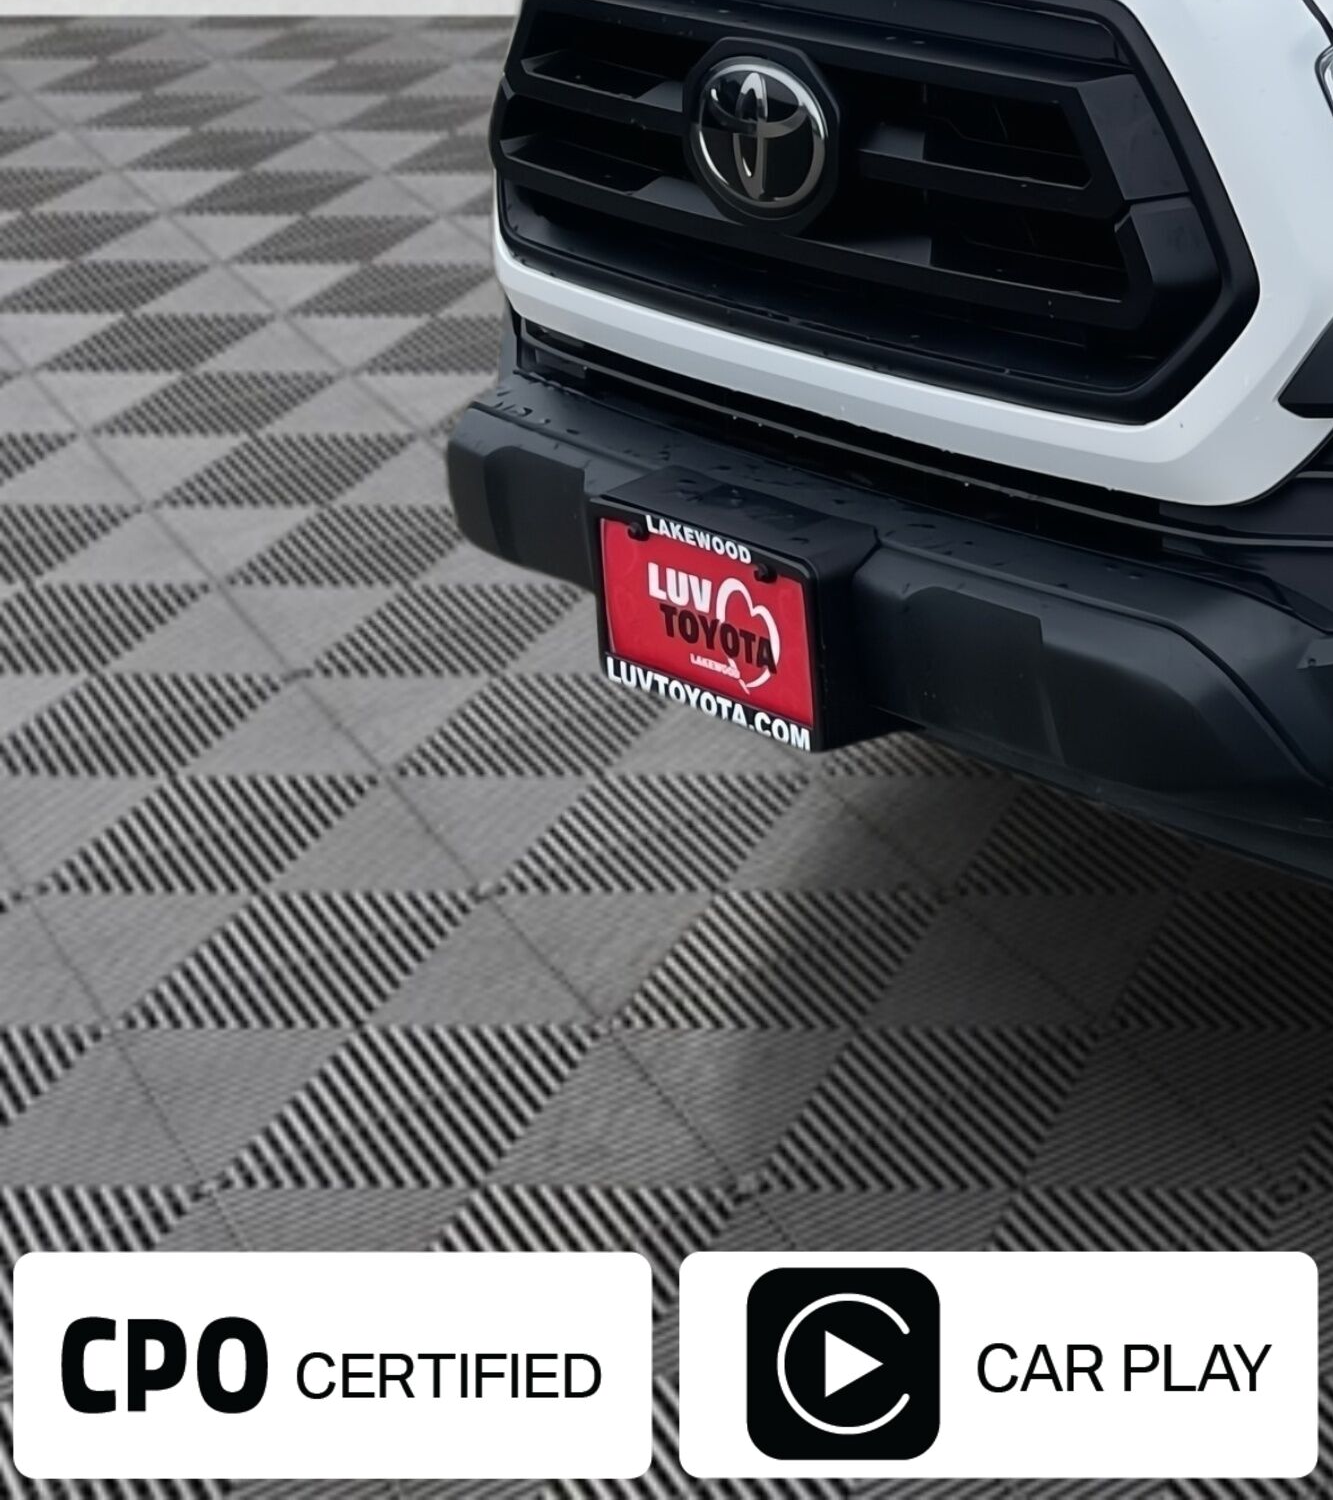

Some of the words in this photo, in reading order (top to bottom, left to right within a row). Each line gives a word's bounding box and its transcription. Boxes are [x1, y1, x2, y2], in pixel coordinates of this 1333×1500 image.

[645, 514, 752, 564] LAKEWOOD
[647, 561, 712, 614] LUV
[659, 603, 778, 675] TOYOTA
[689, 653, 741, 680] LAKEWOOD
[606, 656, 812, 752] LUVTOYOTA.COM
